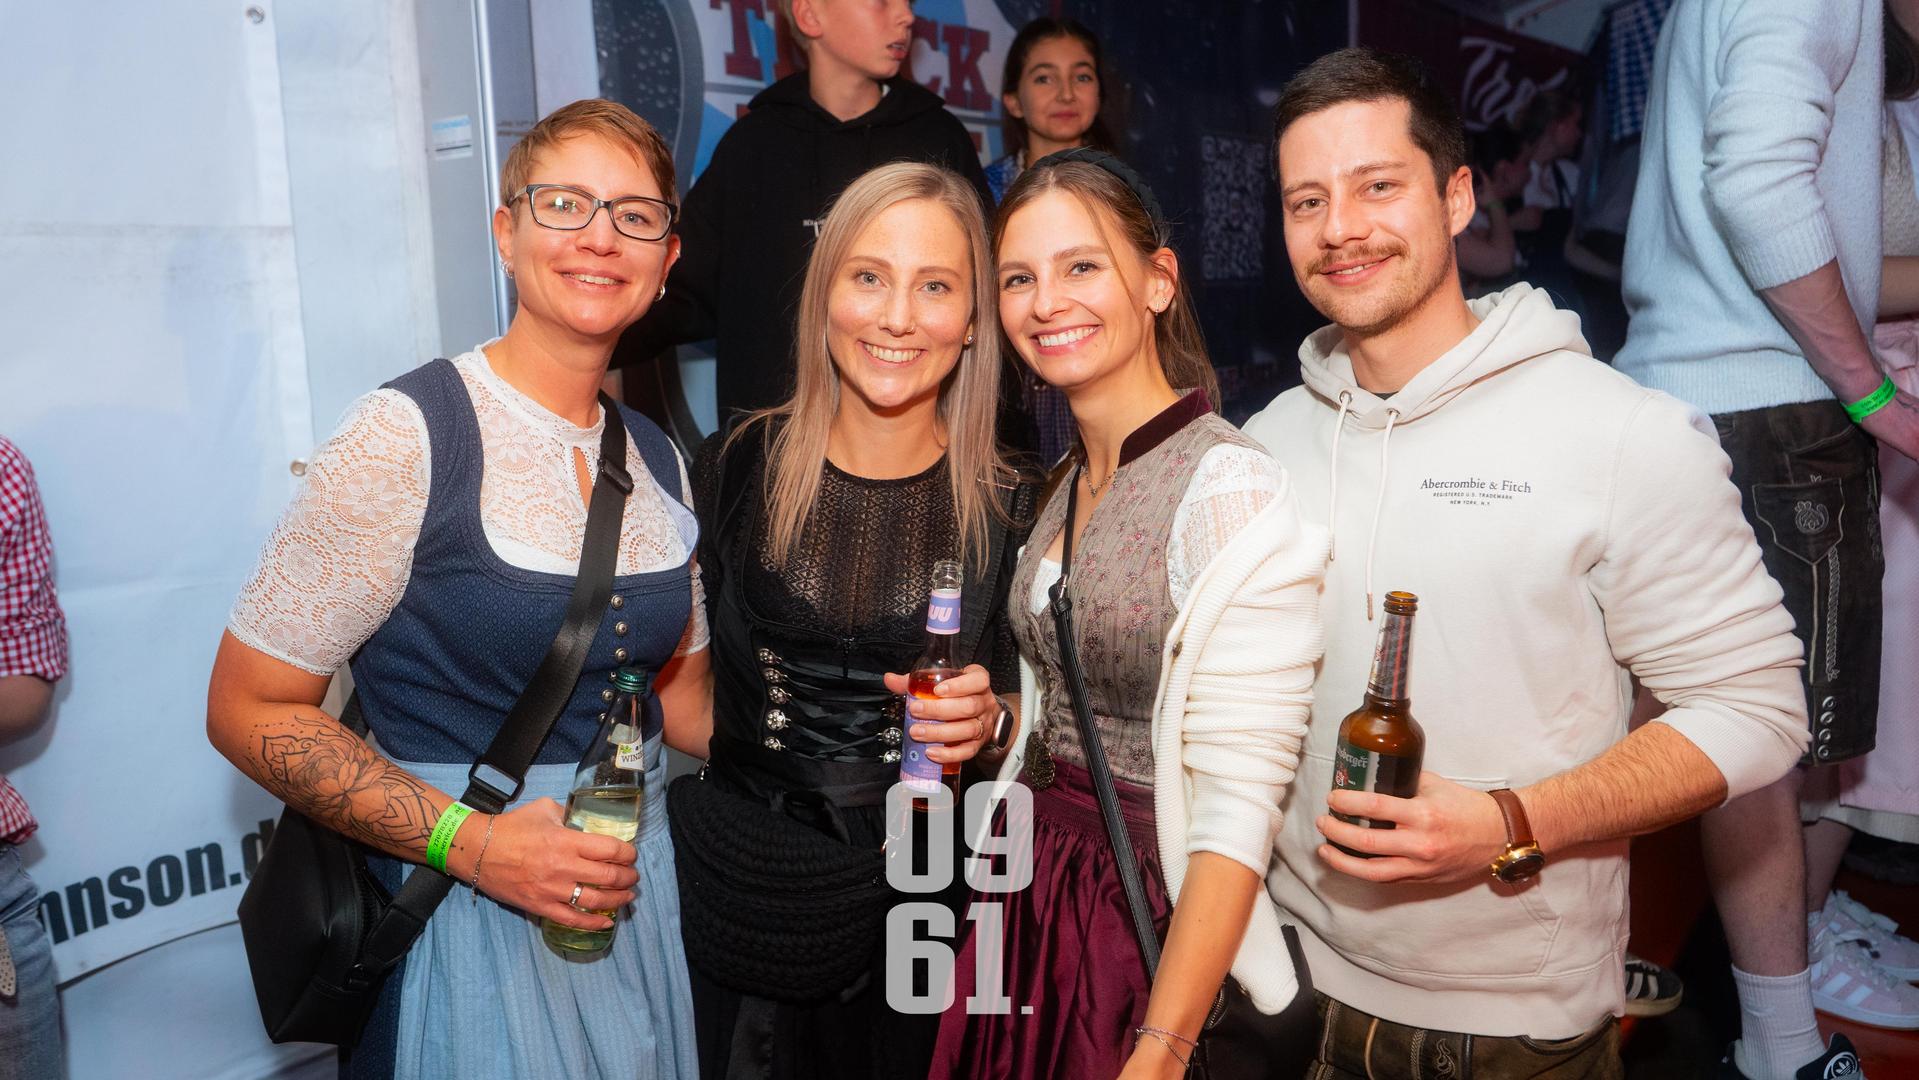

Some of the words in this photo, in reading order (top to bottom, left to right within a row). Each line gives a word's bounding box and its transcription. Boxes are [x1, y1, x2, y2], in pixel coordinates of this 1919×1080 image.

[710, 0, 993, 112] TCK
[1420, 478, 1486, 490] Abercrombie
[1489, 481, 1498, 490] &
[1501, 479, 1532, 494] Fitch
